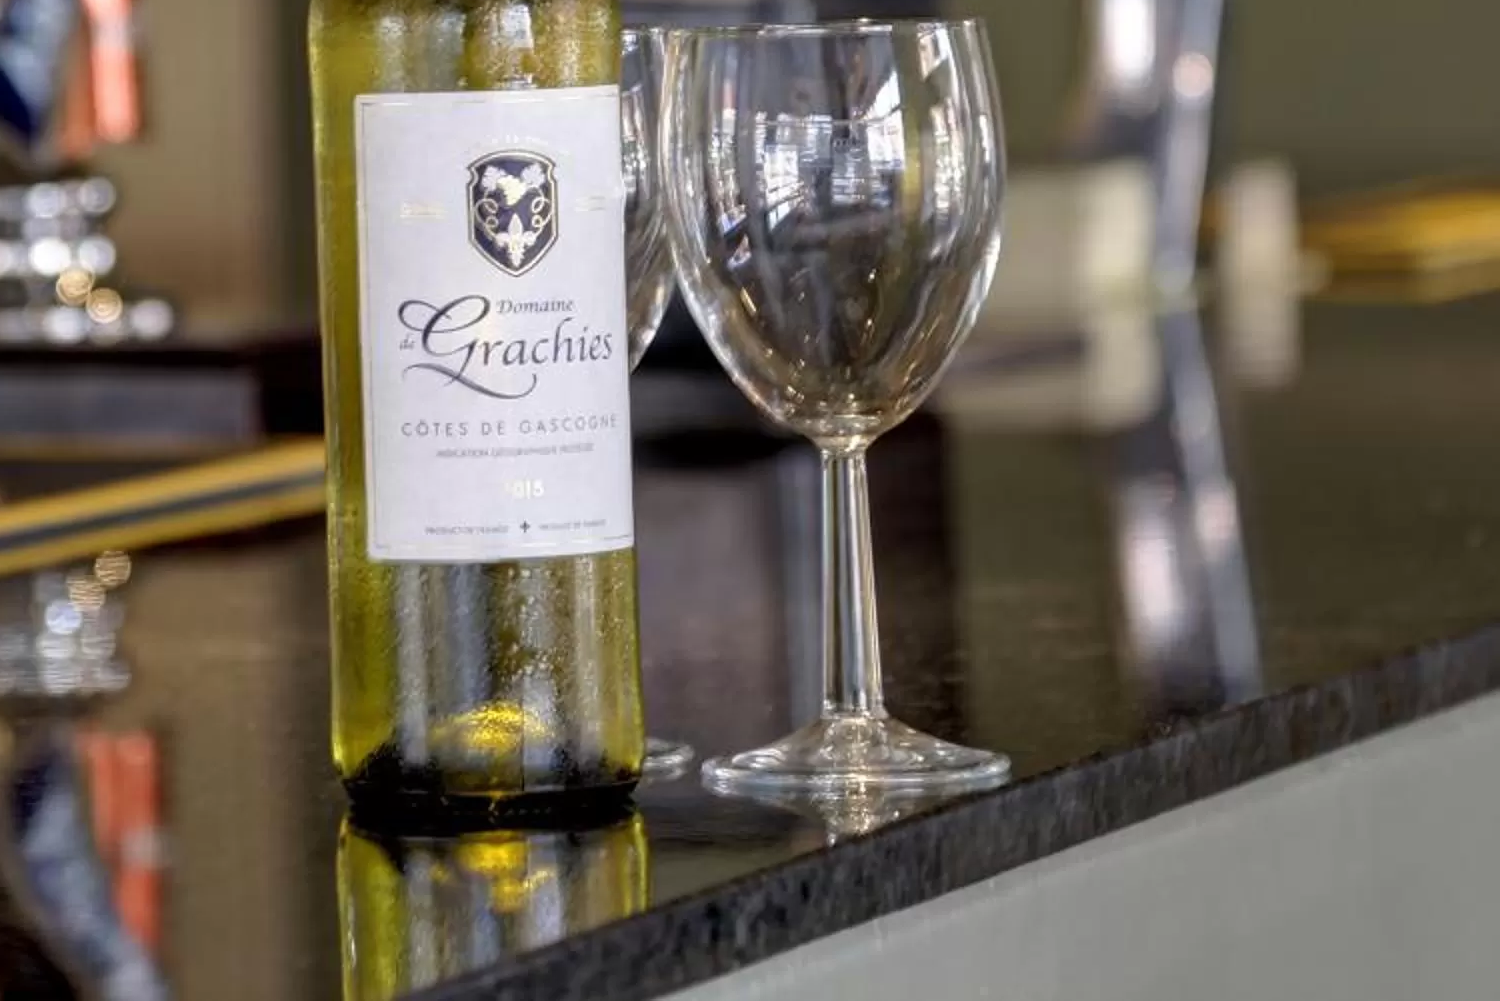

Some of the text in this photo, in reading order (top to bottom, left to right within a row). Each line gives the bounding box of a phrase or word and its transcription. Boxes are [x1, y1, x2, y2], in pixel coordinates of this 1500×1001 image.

[497, 299, 575, 314] Domaine
[398, 295, 613, 399] de Grachies
[401, 413, 617, 437] CÔTES DE GASCOGNE
